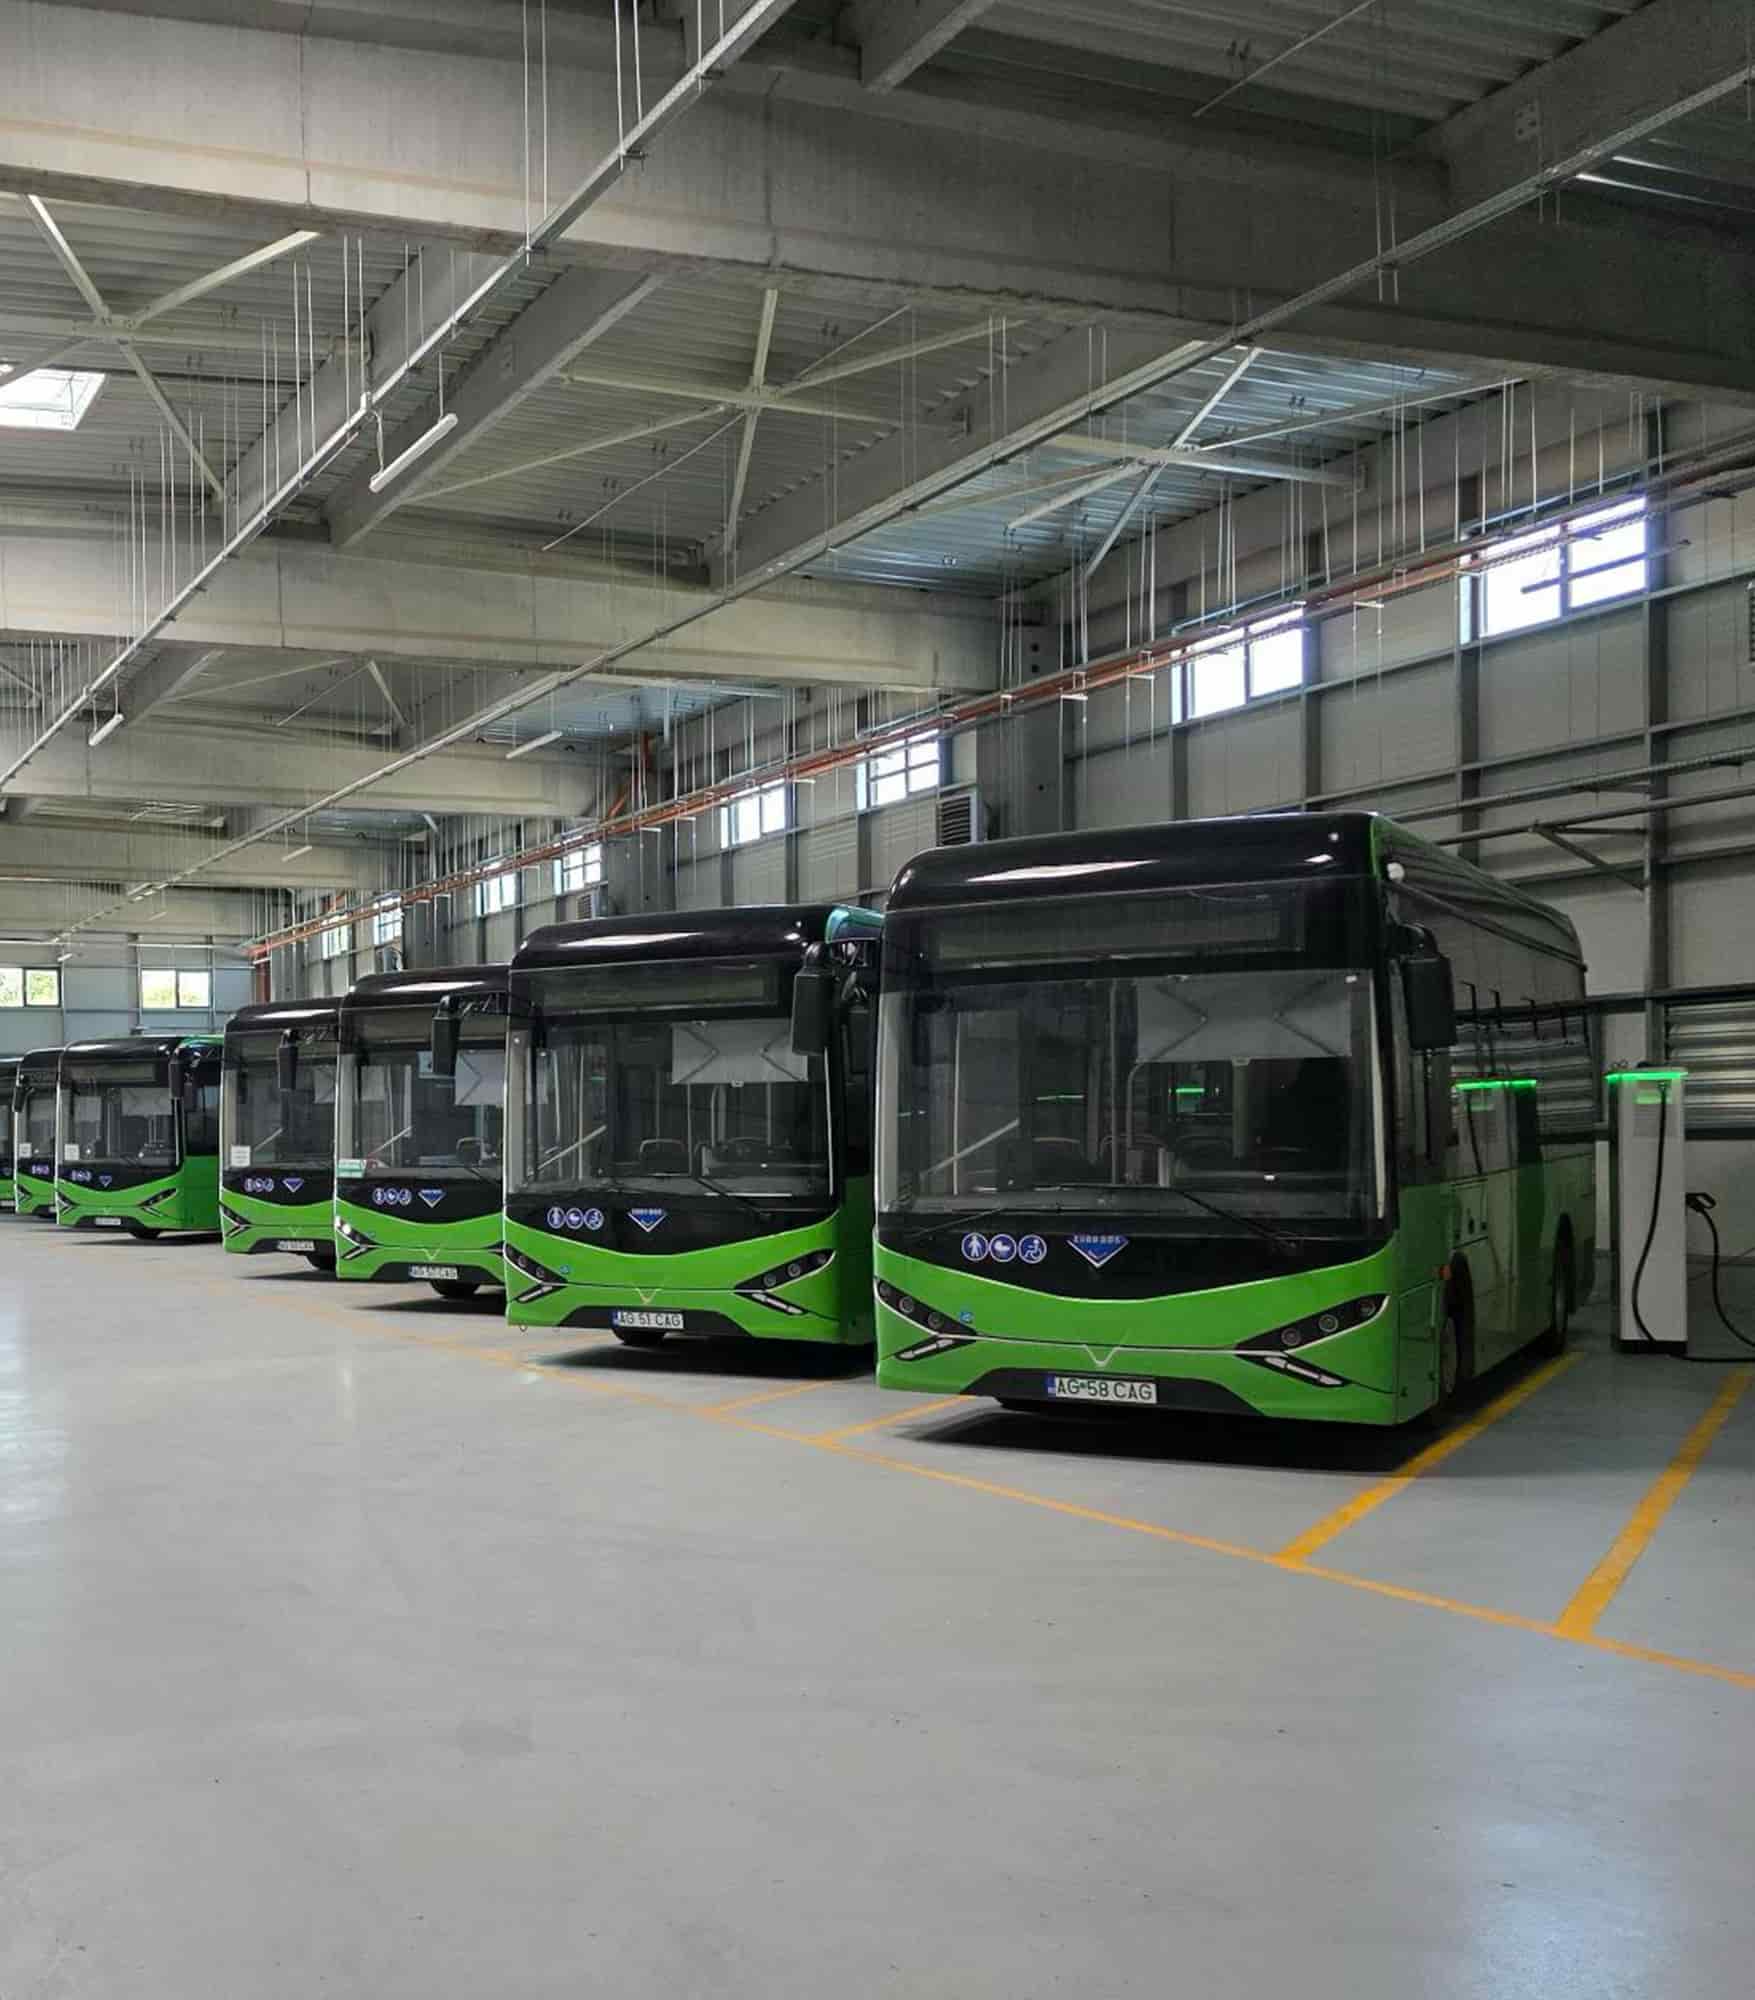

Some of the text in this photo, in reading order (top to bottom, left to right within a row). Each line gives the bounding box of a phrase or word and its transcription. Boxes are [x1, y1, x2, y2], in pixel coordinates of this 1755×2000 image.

[1057, 1377, 1079, 1394] AG
[1088, 1380, 1109, 1397] 58
[1113, 1382, 1152, 1400] CAG
